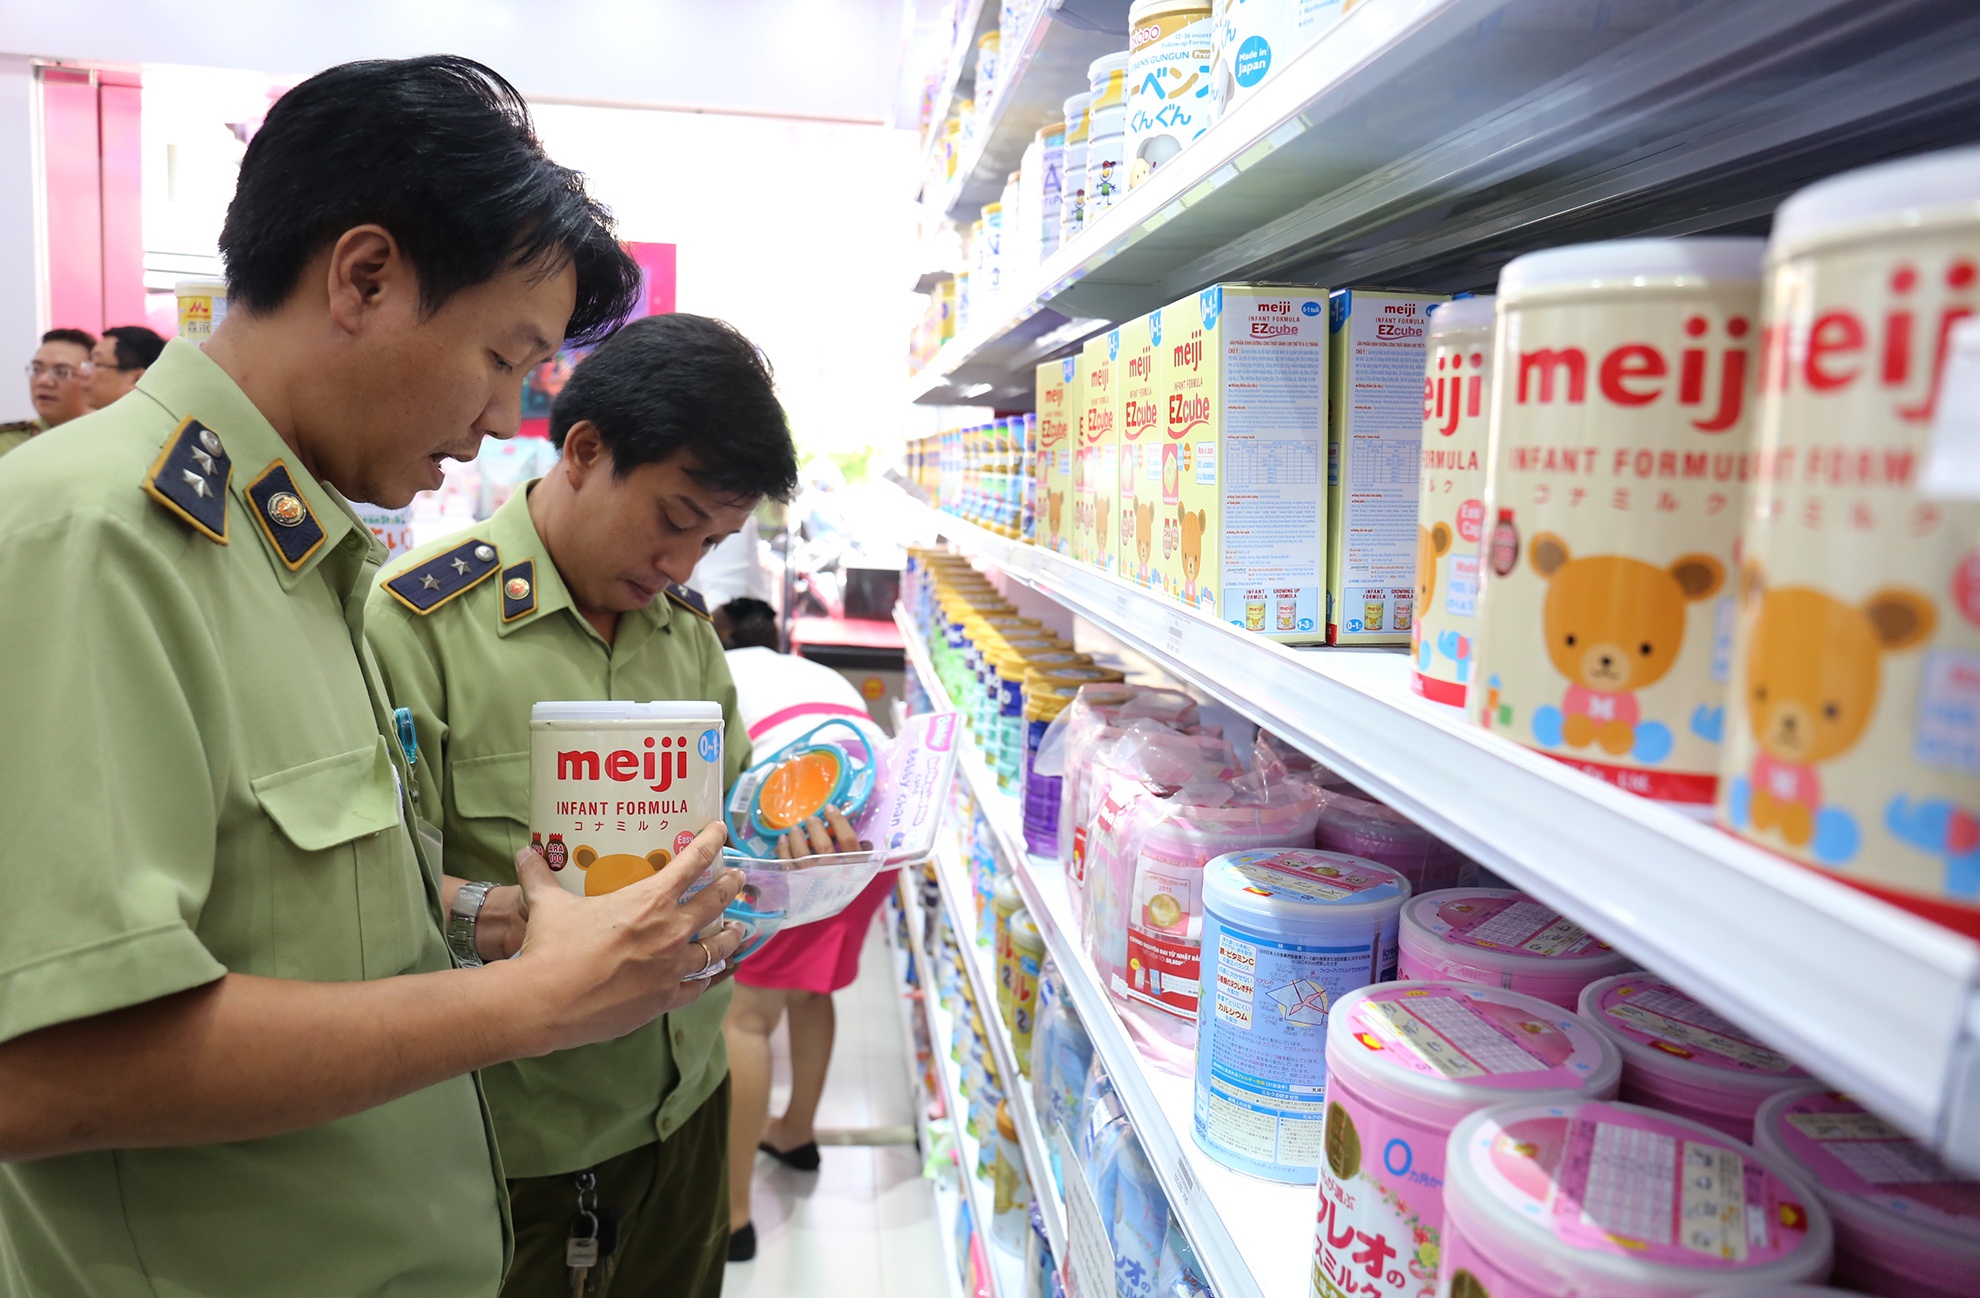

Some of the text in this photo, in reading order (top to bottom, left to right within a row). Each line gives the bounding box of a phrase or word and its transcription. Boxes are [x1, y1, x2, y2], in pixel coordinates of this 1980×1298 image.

[1239, 51, 1257, 62] Made
[1238, 60, 1266, 77] Japan
[1258, 301, 1290, 315] meiji
[1384, 303, 1416, 317] meiji
[1252, 323, 1298, 334] EZcube
[1378, 324, 1423, 336] EZcube
[1173, 329, 1202, 372] meiji
[1129, 345, 1151, 382] meiji
[1091, 360, 1109, 391] meiji
[1516, 316, 1750, 433] meij
[1126, 400, 1157, 427] EZcube
[1169, 393, 1210, 424] EZcube
[1088, 408, 1113, 431] EZcube
[1510, 447, 1599, 475] INFANT
[1533, 483, 1727, 516] コナミルク
[557, 736, 688, 793] meiji
[556, 799, 689, 816] INFANT FORMULA
[573, 819, 670, 832] コナミルク
[548, 843, 564, 854] ARA
[549, 853, 564, 864] 100
[1218, 1003, 1248, 1021] カルシウム
